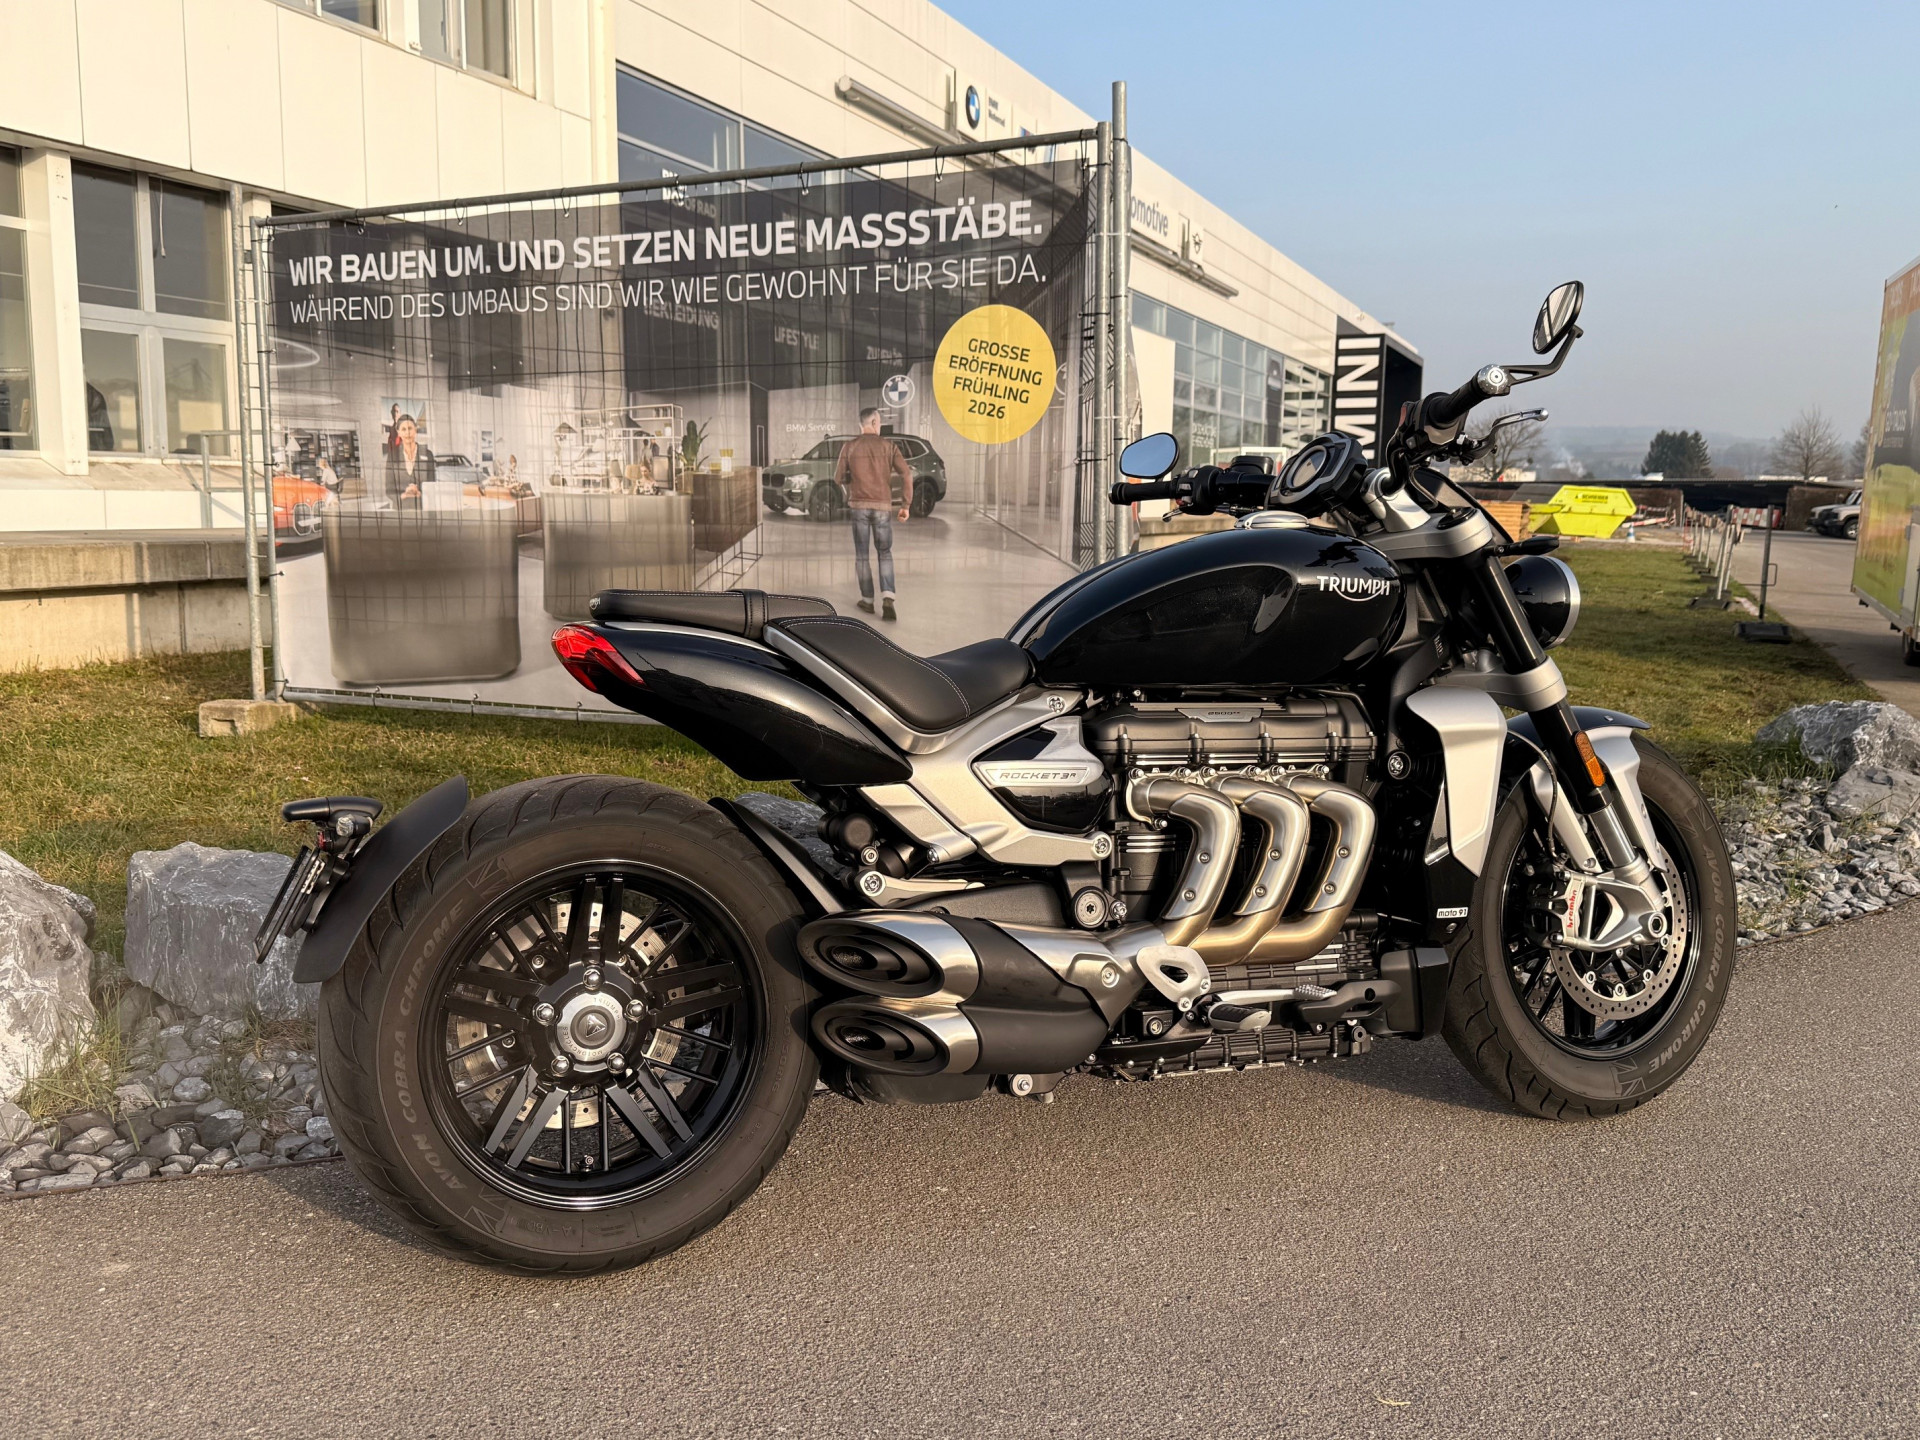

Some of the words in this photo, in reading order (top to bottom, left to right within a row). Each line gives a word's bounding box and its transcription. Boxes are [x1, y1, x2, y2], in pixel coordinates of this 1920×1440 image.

[288, 255, 334, 287] WIR
[340, 249, 437, 284] BAUEN
[444, 245, 491, 278] UM.
[497, 239, 566, 272] UND
[573, 228, 696, 269] SETZEN
[705, 220, 797, 260] NEUE
[806, 197, 1043, 254] MASSSTÄBE.
[1130, 195, 1169, 237] omotive
[290, 294, 394, 324] WÄHREND
[400, 292, 445, 319] DES
[451, 286, 549, 318] UMBAUS
[556, 283, 612, 311] SIND
[620, 280, 665, 307] WIR
[671, 275, 720, 305] WIE
[725, 265, 868, 302] GEWOHNT
[874, 256, 934, 294] FÜR
[941, 256, 988, 289] SIE
[996, 254, 1047, 286] DA.
[949, 354, 1043, 386] ERÖFFNUNG
[968, 337, 1031, 363] GROSSE
[953, 376, 1031, 404] FRÜHLING
[967, 399, 1006, 420] 2026
[1334, 336, 1381, 461] MINI
[786, 422, 806, 433] BMW
[807, 422, 836, 433] Service
[1316, 575, 1391, 602] TRIUMPH
[1703, 843, 1725, 907] AVON
[1438, 909, 1458, 918] moto
[399, 898, 465, 1017] CHROME
[1704, 912, 1726, 994] COBRA
[1648, 999, 1708, 1075] CHROME
[393, 1030, 418, 1124] COBRA
[412, 1133, 468, 1190] AVON
